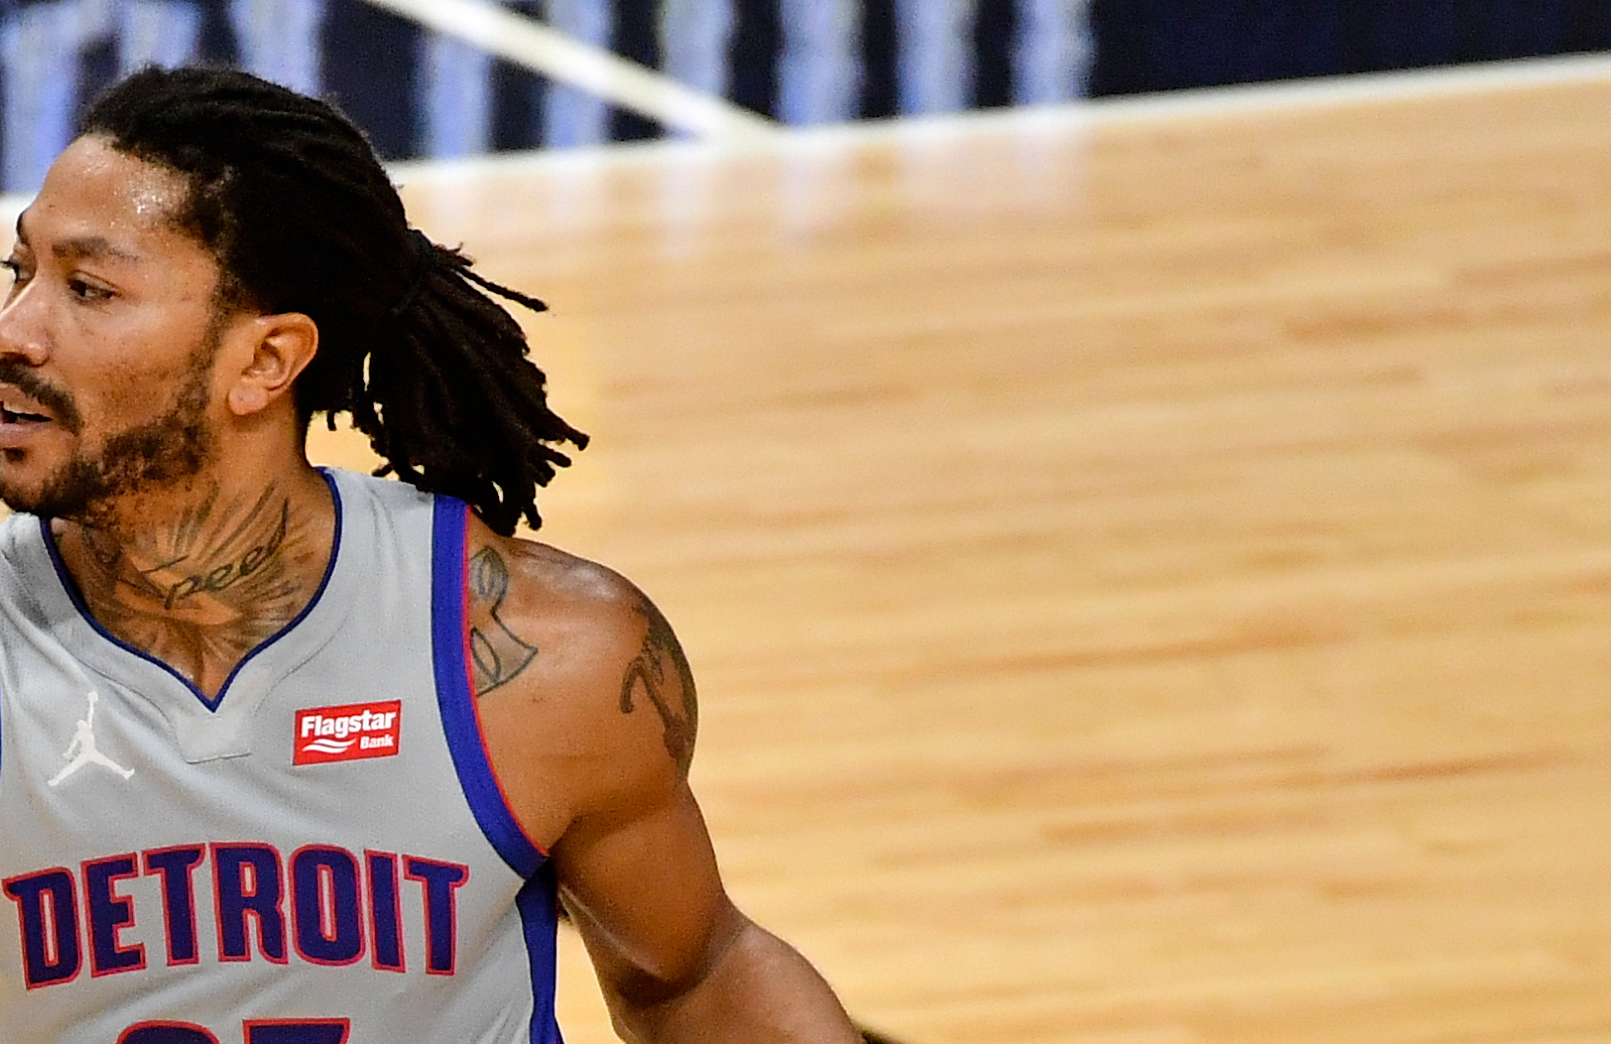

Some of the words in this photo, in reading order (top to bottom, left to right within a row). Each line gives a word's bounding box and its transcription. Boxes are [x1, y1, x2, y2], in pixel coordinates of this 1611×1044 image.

[300, 709, 396, 739] Flagstar
[359, 734, 394, 750] Bank
[1, 842, 469, 990] DETROIT
